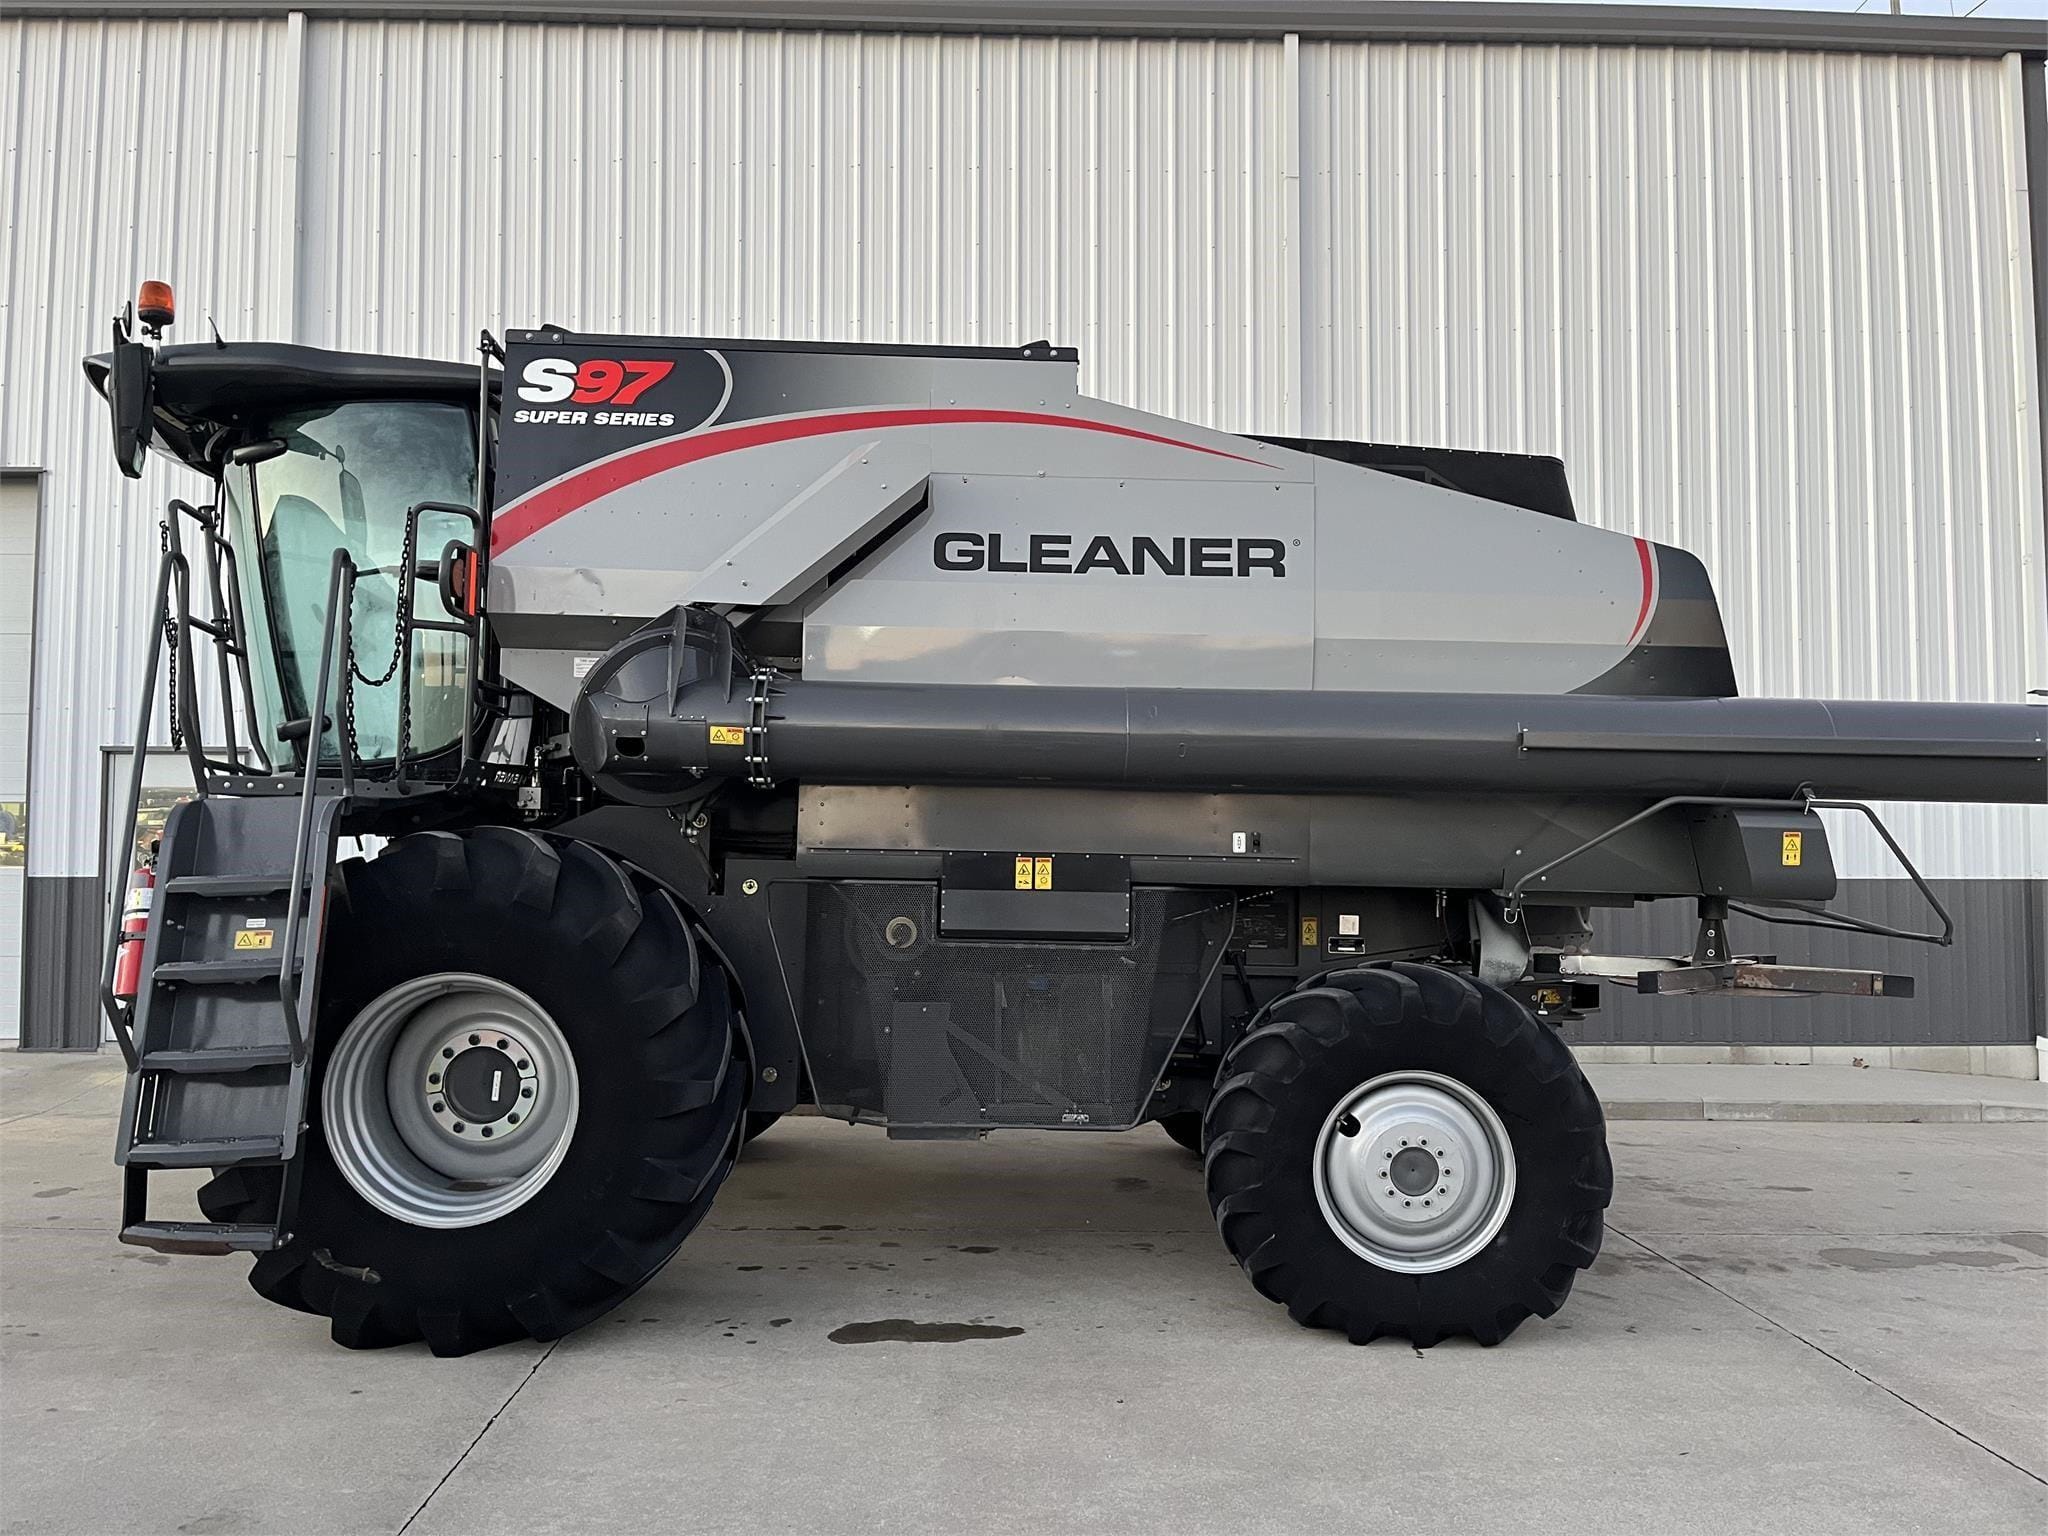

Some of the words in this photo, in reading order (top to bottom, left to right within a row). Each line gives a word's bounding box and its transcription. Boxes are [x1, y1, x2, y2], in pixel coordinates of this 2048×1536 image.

[517, 358, 674, 405] S97
[513, 410, 588, 425] SUPER
[593, 411, 675, 427] SERIES
[933, 532, 1286, 578] GLEANER
